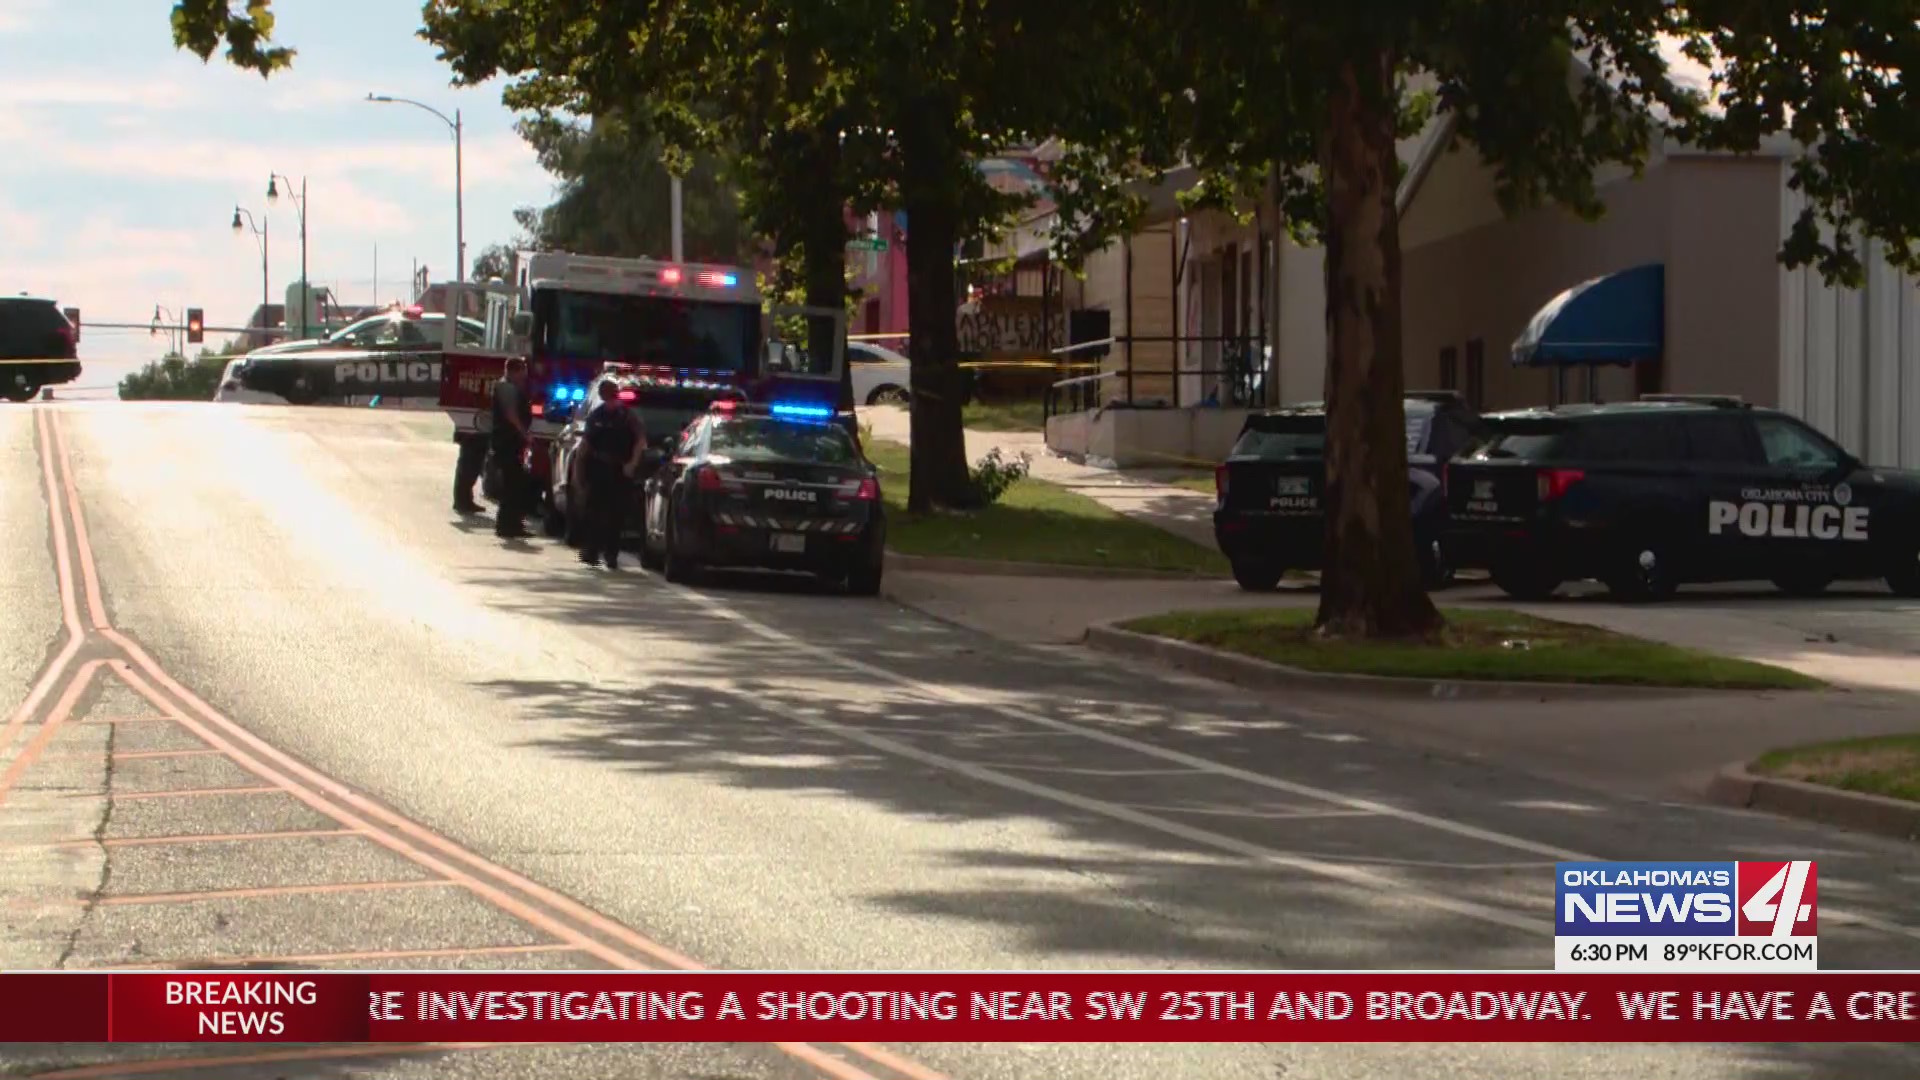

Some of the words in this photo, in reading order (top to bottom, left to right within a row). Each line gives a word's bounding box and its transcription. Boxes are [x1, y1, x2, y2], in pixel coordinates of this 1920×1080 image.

[763, 489, 818, 502] POLICE
[1741, 488, 1803, 500] OKLAHOMA
[1805, 490, 1830, 501] CITY
[1269, 496, 1319, 508] POLICE
[1708, 500, 1870, 541] POLICE
